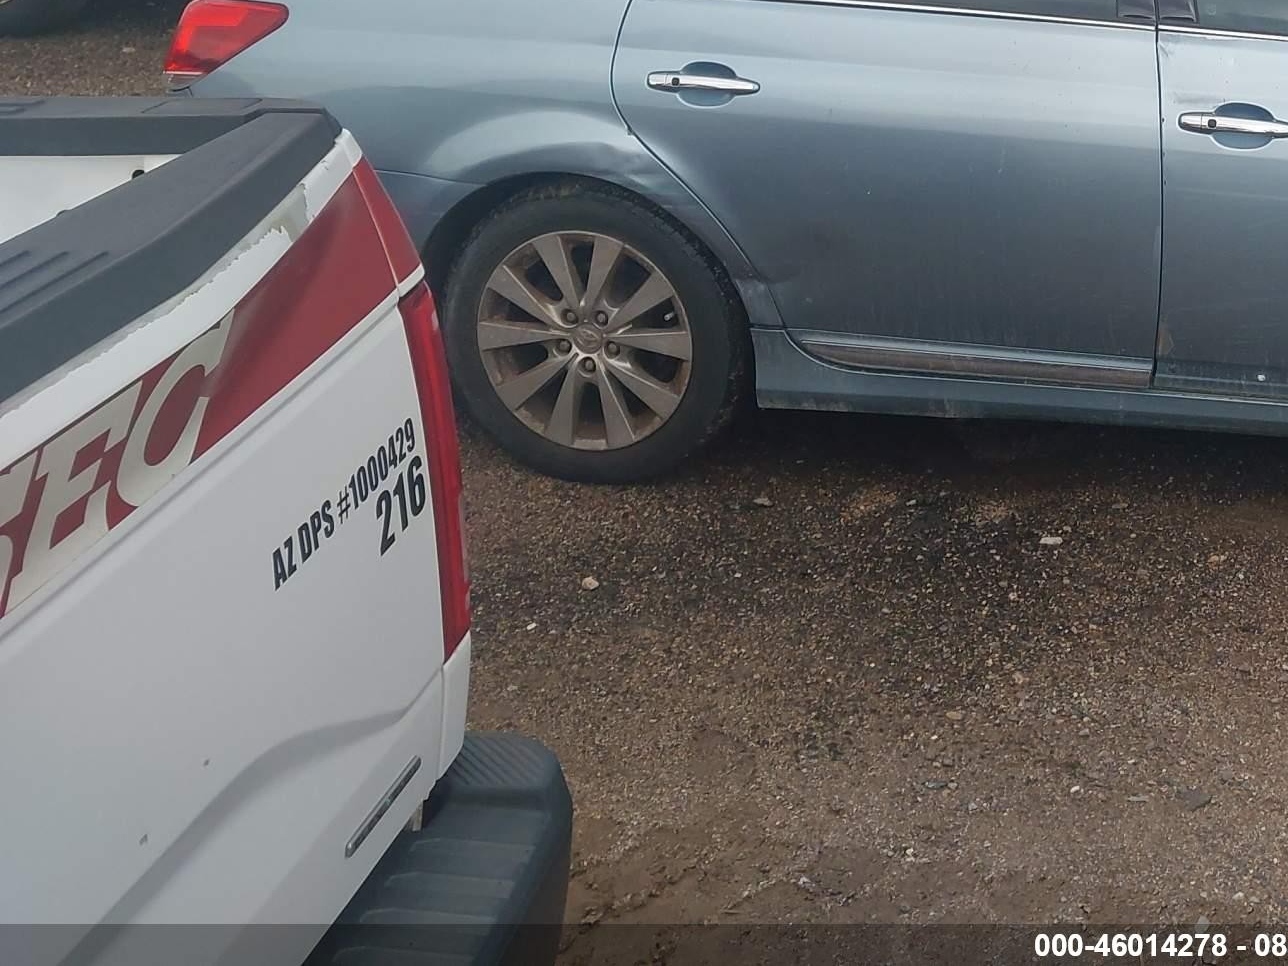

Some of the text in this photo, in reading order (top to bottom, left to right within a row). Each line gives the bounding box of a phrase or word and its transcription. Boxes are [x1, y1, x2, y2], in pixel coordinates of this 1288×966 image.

[272, 417, 416, 591] AZ DPS #1000429
[375, 455, 426, 556] 216
